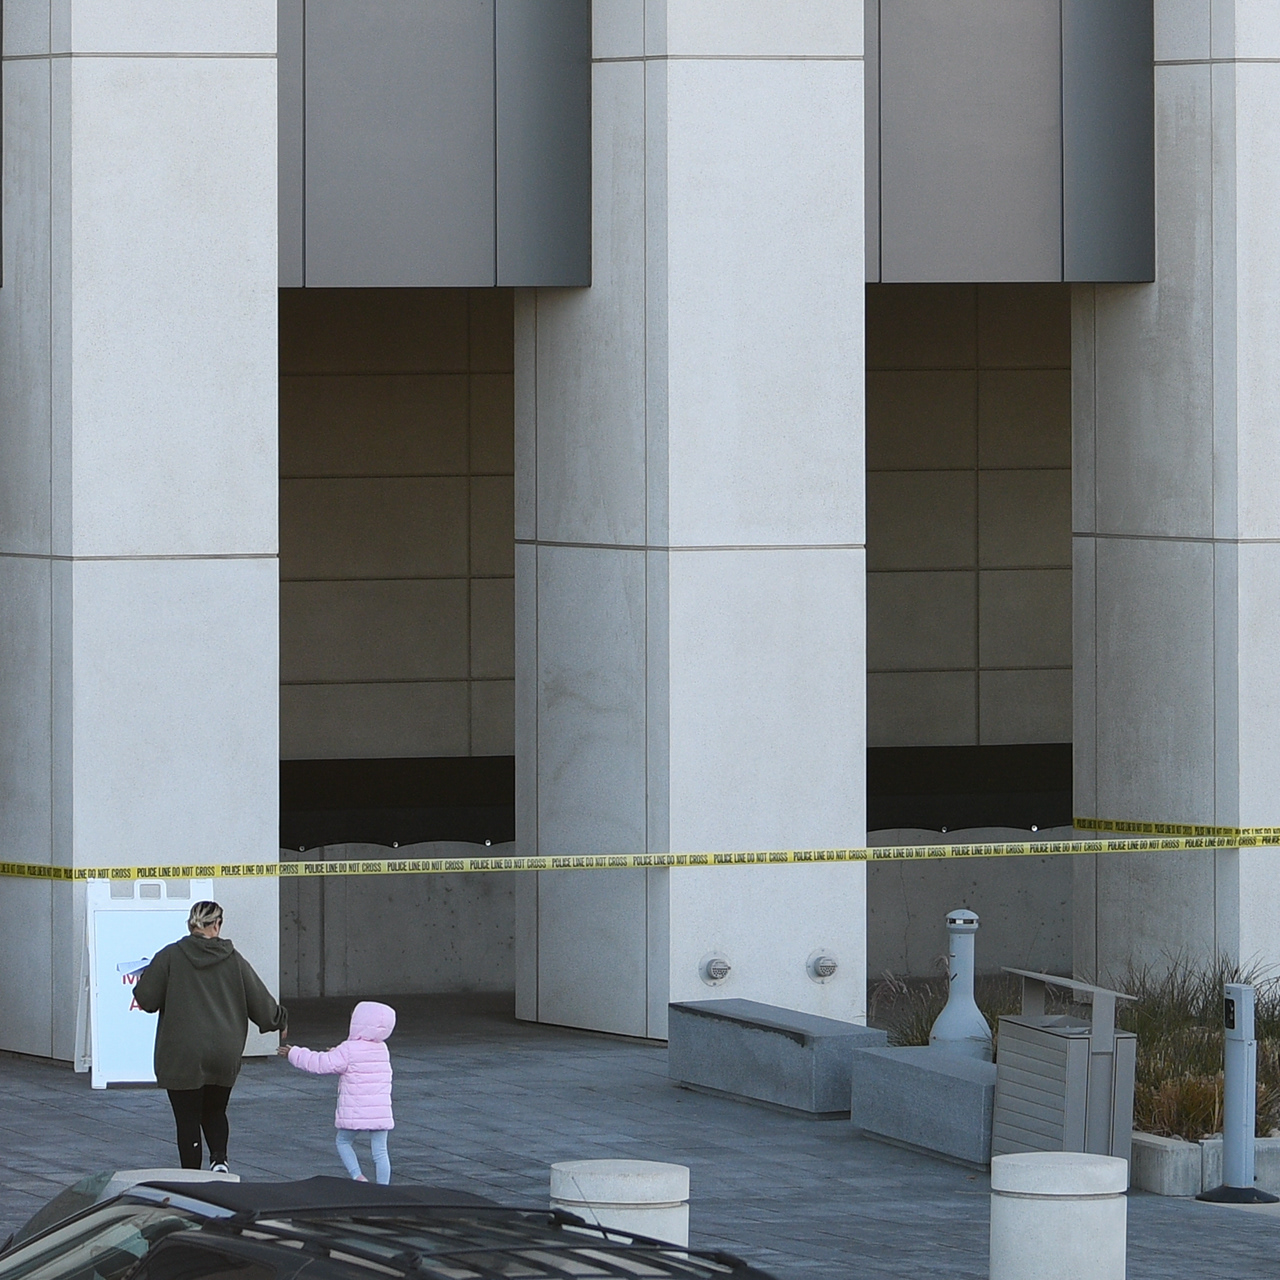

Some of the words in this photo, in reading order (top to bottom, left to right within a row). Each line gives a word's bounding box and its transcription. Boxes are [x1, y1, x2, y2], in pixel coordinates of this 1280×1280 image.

[951, 846, 970, 857] POLICE
[971, 846, 983, 856] LINE
[984, 845, 992, 855] DO
[993, 845, 1004, 855] NOT
[1006, 844, 1024, 854] CROSS
[1107, 841, 1126, 851] POLICE
[1127, 840, 1139, 850] LINE
[1139, 840, 1148, 850] DO
[1149, 839, 1160, 849] NOT
[1161, 838, 1180, 849] CROSS
[714, 853, 733, 864] POLICE
[734, 853, 746, 863] LINE
[747, 853, 755, 863] DO
[756, 852, 767, 863] NOT
[769, 852, 788, 862] CROSS
[793, 851, 812, 861] POLICE
[813, 851, 826, 861] LINE
[826, 851, 834, 860] DO
[836, 850, 847, 860] NOT
[848, 850, 867, 860] CROSS
[872, 849, 892, 859] POLICE
[893, 849, 905, 858] LINE
[905, 848, 913, 858] DO
[915, 848, 926, 858] NOT
[927, 847, 946, 857] CROSS
[387, 861, 407, 871] POLICE
[408, 861, 421, 871] LINE
[421, 861, 430, 871] DO
[431, 861, 443, 870] NOT
[445, 860, 464, 870] CROSS
[470, 859, 490, 870] POLICE
[491, 859, 503, 869] LINE
[504, 859, 512, 869] DO
[514, 859, 525, 869] NOT
[527, 858, 546, 868] CROSS
[552, 858, 571, 868] POLICE
[572, 857, 585, 867] LINE
[585, 857, 594, 867] DO
[595, 857, 607, 867] NOT
[608, 857, 627, 867] CROSS
[633, 856, 652, 866] POLICE
[653, 856, 666, 866] LINE
[666, 855, 675, 865] DO
[676, 855, 687, 865] NOT
[689, 855, 708, 865] CROSS
[74, 869, 86, 879] LINE
[98, 868, 109, 878] NOT
[111, 868, 131, 878] CROSS
[137, 867, 157, 878] POLICE
[158, 867, 171, 877] LINE
[172, 867, 180, 877] DO
[182, 866, 194, 877] NOT
[195, 866, 215, 876] CROSS
[221, 865, 241, 876] POLICE
[242, 864, 255, 875] LINE
[255, 864, 264, 875] DO
[265, 864, 277, 875] NOT
[279, 863, 298, 874] CROSS
[304, 863, 324, 874] POLICE
[326, 863, 338, 873] LINE
[339, 862, 347, 872] DO
[349, 862, 360, 872] NOT
[362, 862, 381, 872] CROSS
